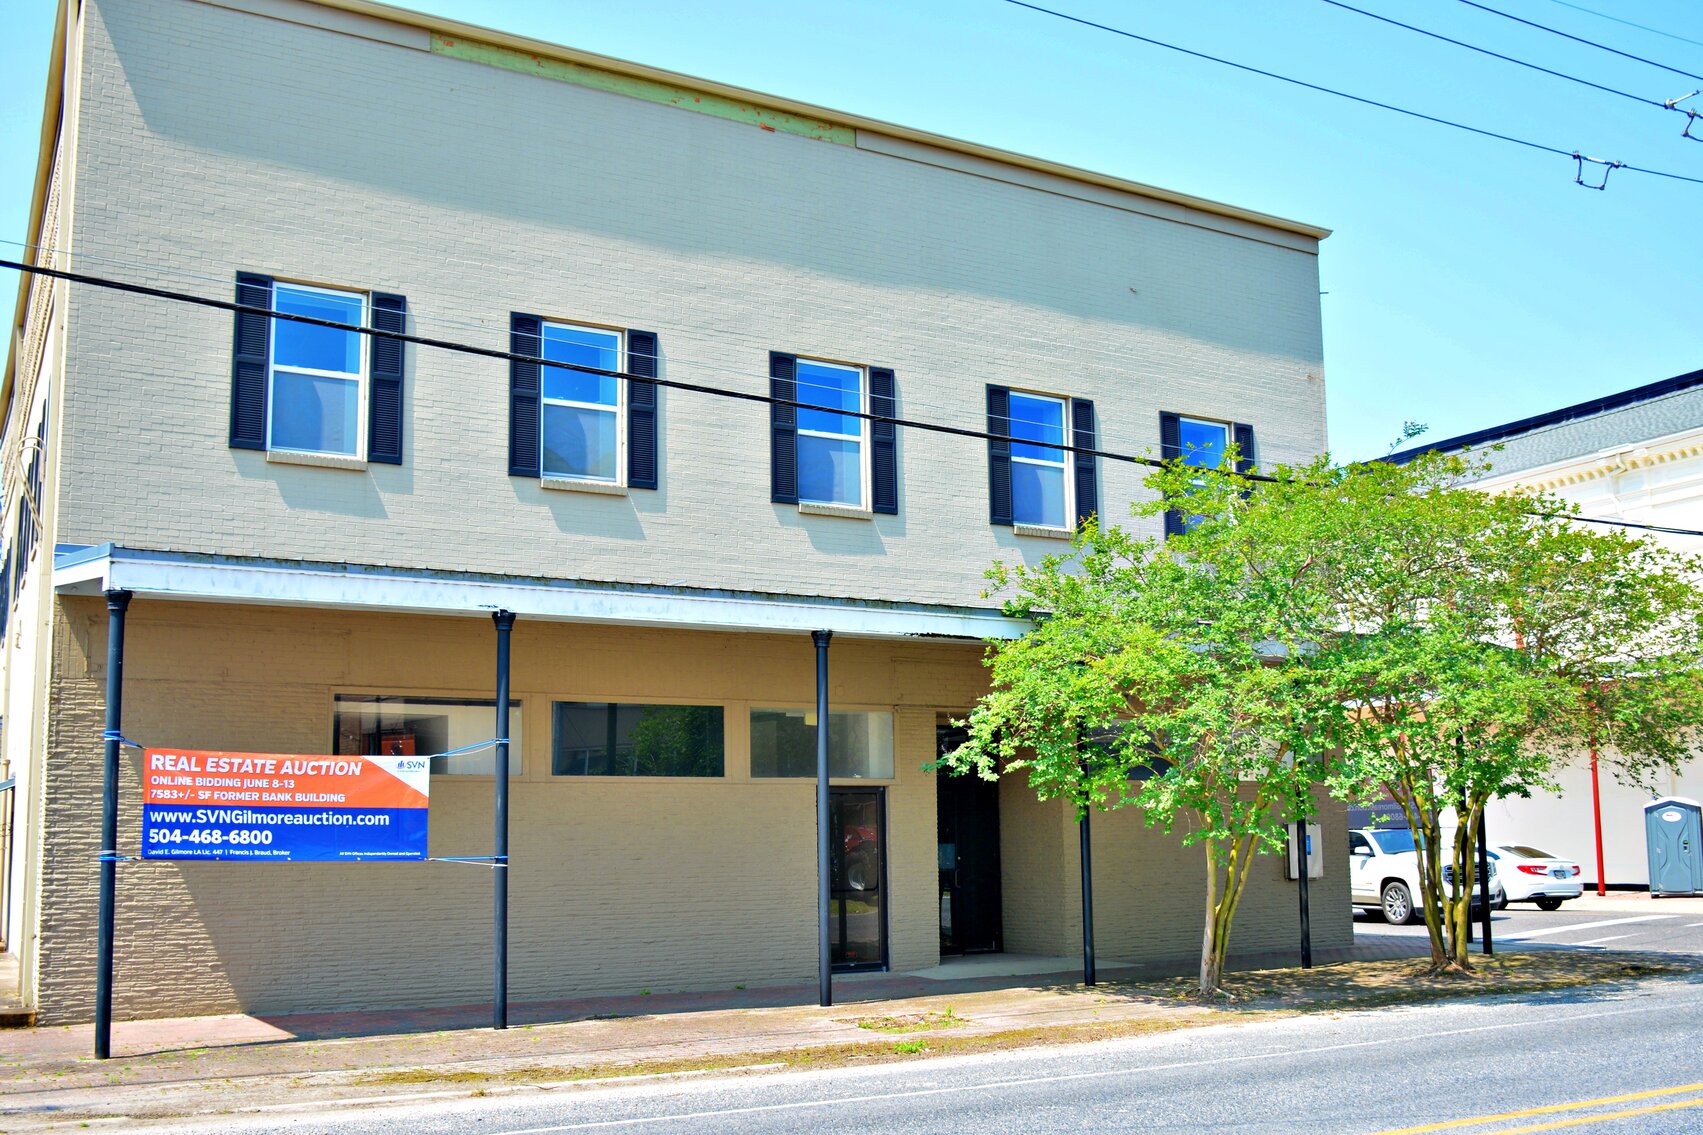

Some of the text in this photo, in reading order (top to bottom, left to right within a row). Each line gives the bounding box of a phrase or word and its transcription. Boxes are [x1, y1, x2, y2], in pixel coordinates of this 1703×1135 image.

[151, 754, 363, 776] REAL ESTATE AUCTION
[406, 760, 426, 769] SVN
[151, 775, 295, 789] ONLINE BIDDING JUNE 8-13
[151, 789, 346, 803] 7583+/- SF FORMER BANK BUILDING
[149, 808, 390, 825] www.SVNGilmoreauction.com
[148, 828, 273, 845] 504-468-6800
